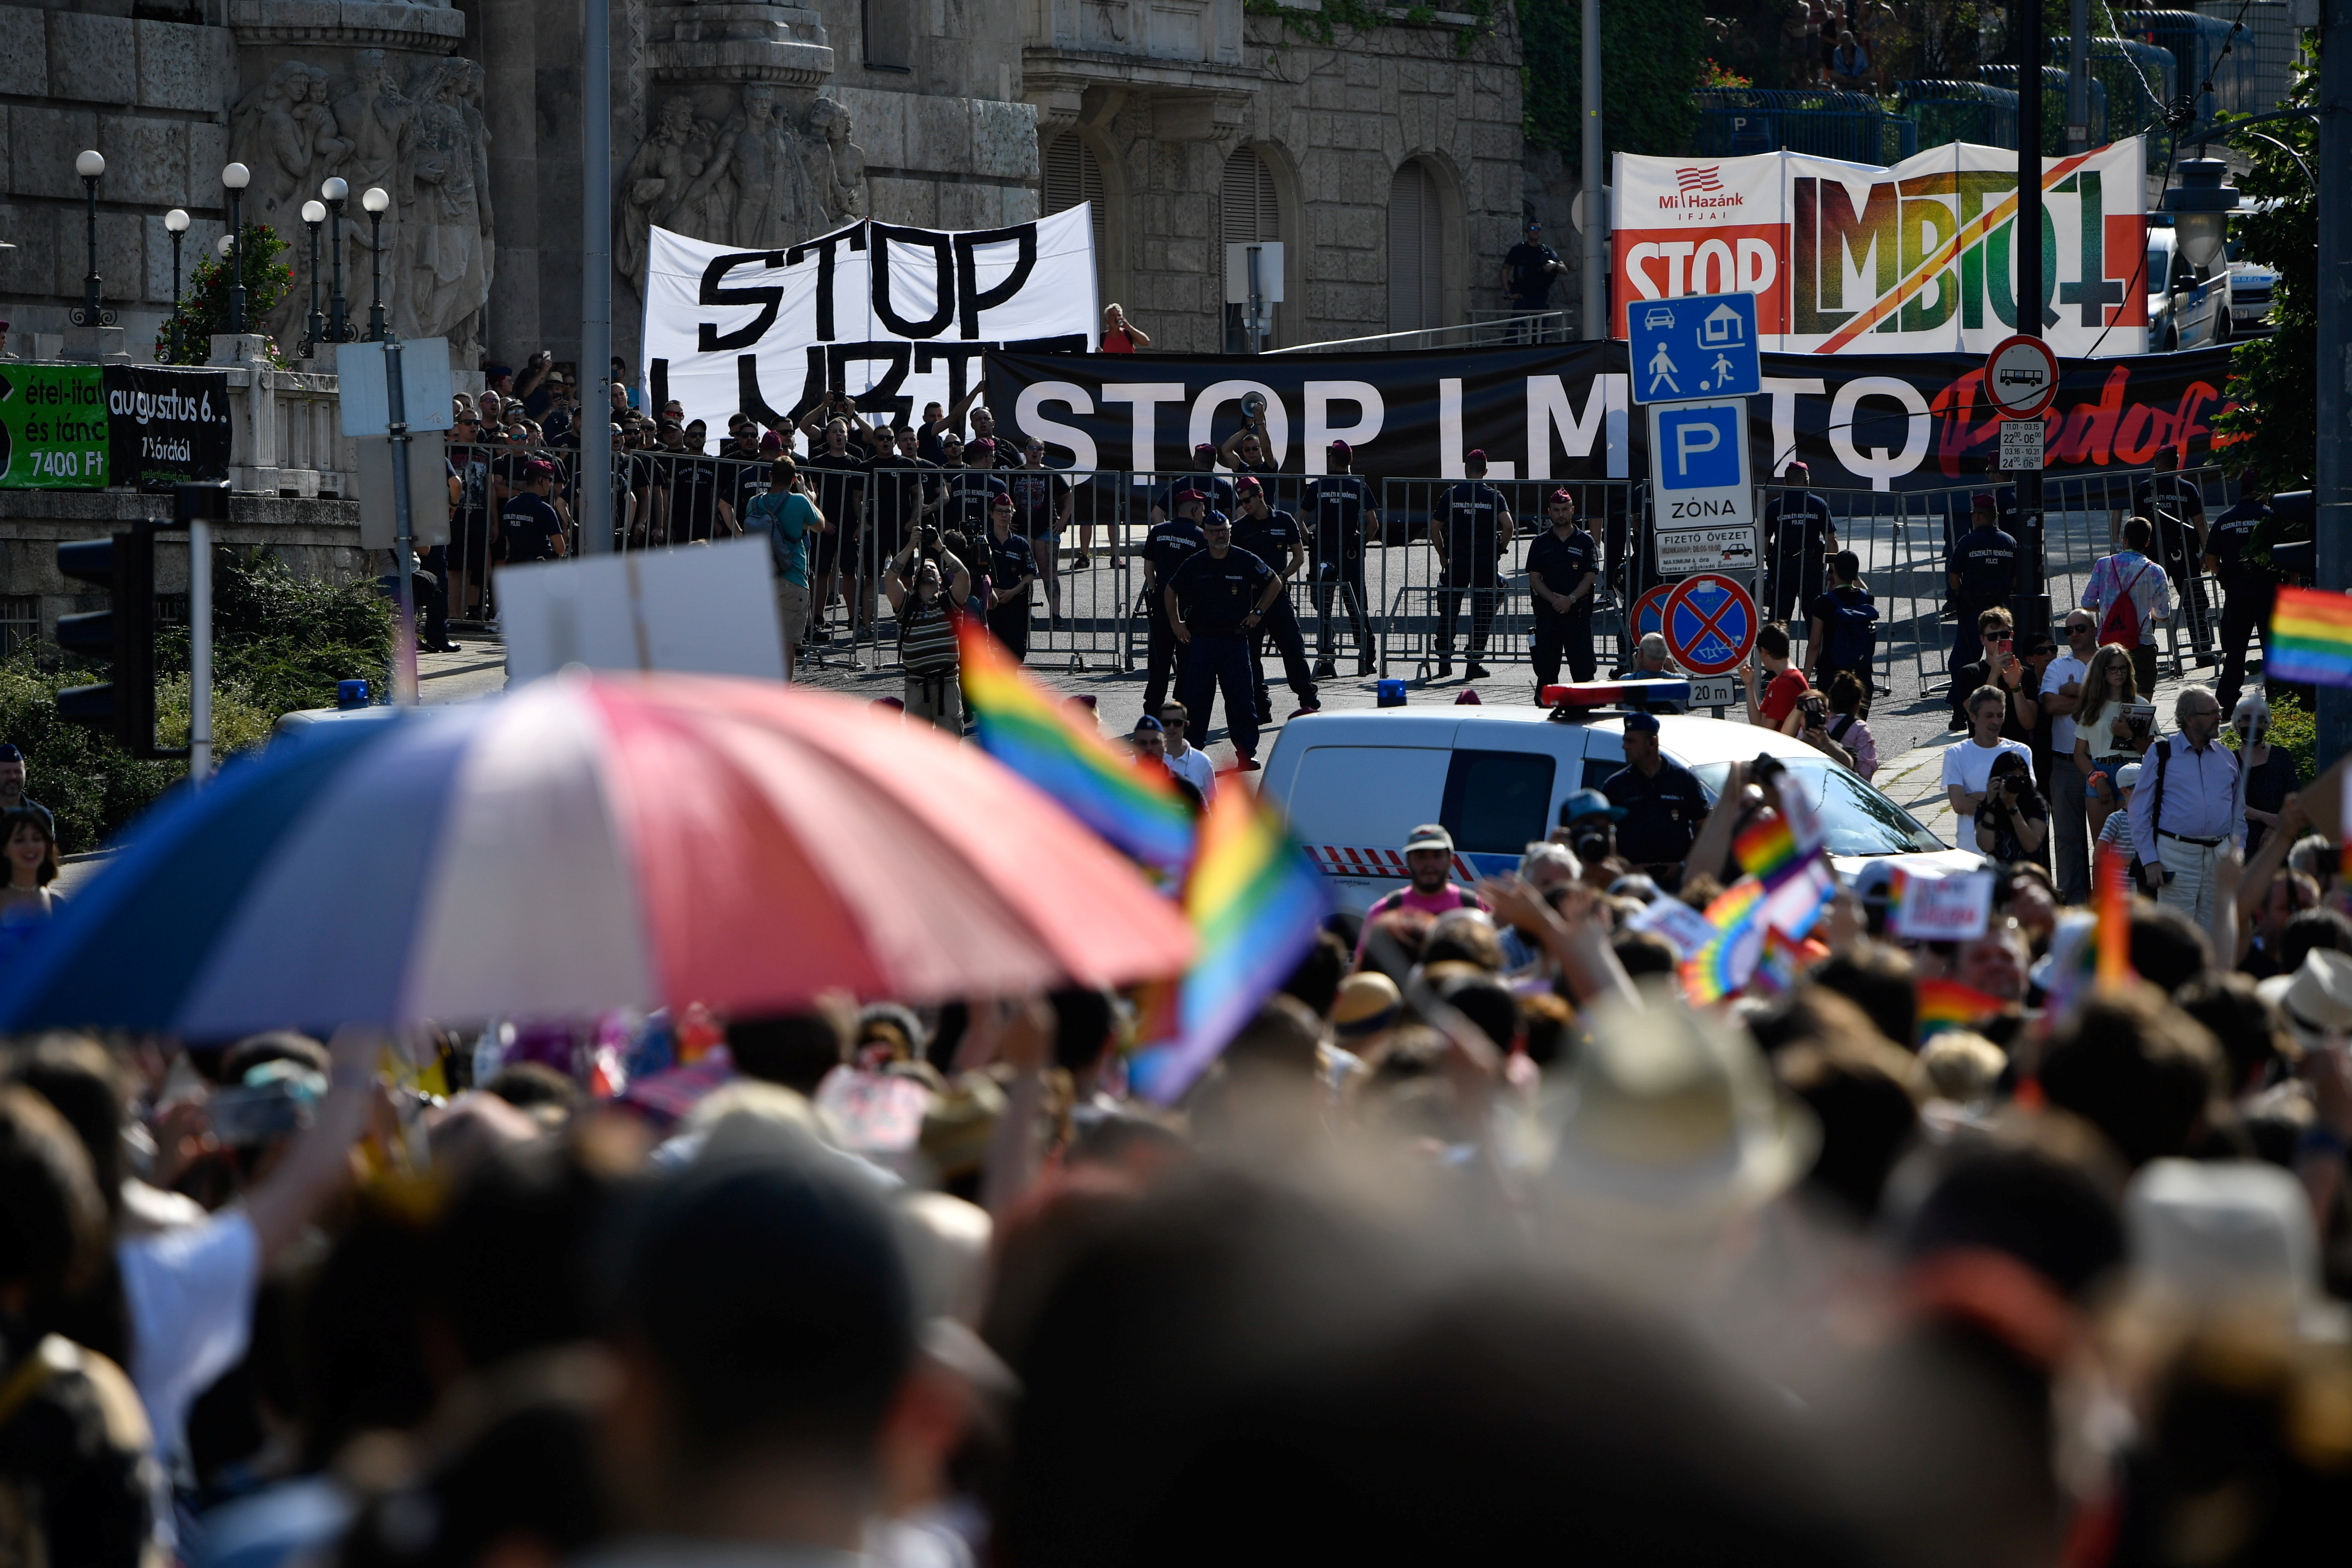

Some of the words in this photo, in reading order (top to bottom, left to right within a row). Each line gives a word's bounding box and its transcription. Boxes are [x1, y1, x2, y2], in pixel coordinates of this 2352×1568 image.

[1734, 117, 1747, 131] P
[1659, 196, 1678, 209] Mi
[1689, 193, 1744, 208] Hazánk
[1679, 212, 1726, 220] IFJAI
[1626, 238, 1776, 301] STOP
[698, 220, 1037, 352] STOP
[25, 376, 105, 405] étel-ital
[110, 388, 197, 425] augusztus
[25, 413, 48, 442] és
[56, 413, 106, 442] tánc
[1015, 380, 1384, 486] STOP
[1440, 373, 1932, 491] LMTQ
[155, 436, 191, 462] órától
[1677, 422, 1720, 475] P
[30, 452, 78, 477] 7400
[85, 451, 103, 476] Ft
[953, 488, 971, 497] KÉSZENÉTI
[1337, 491, 1357, 500] RNDŐRSÉG
[1470, 502, 1492, 510] RNDŐRSÉG
[1671, 497, 1736, 519] ZÓNA
[1665, 533, 1701, 544] FIZETŐ
[1969, 548, 1992, 558] KÉSZENLÉTI
[1695, 685, 1710, 700] 20
[1715, 688, 1727, 700] m
